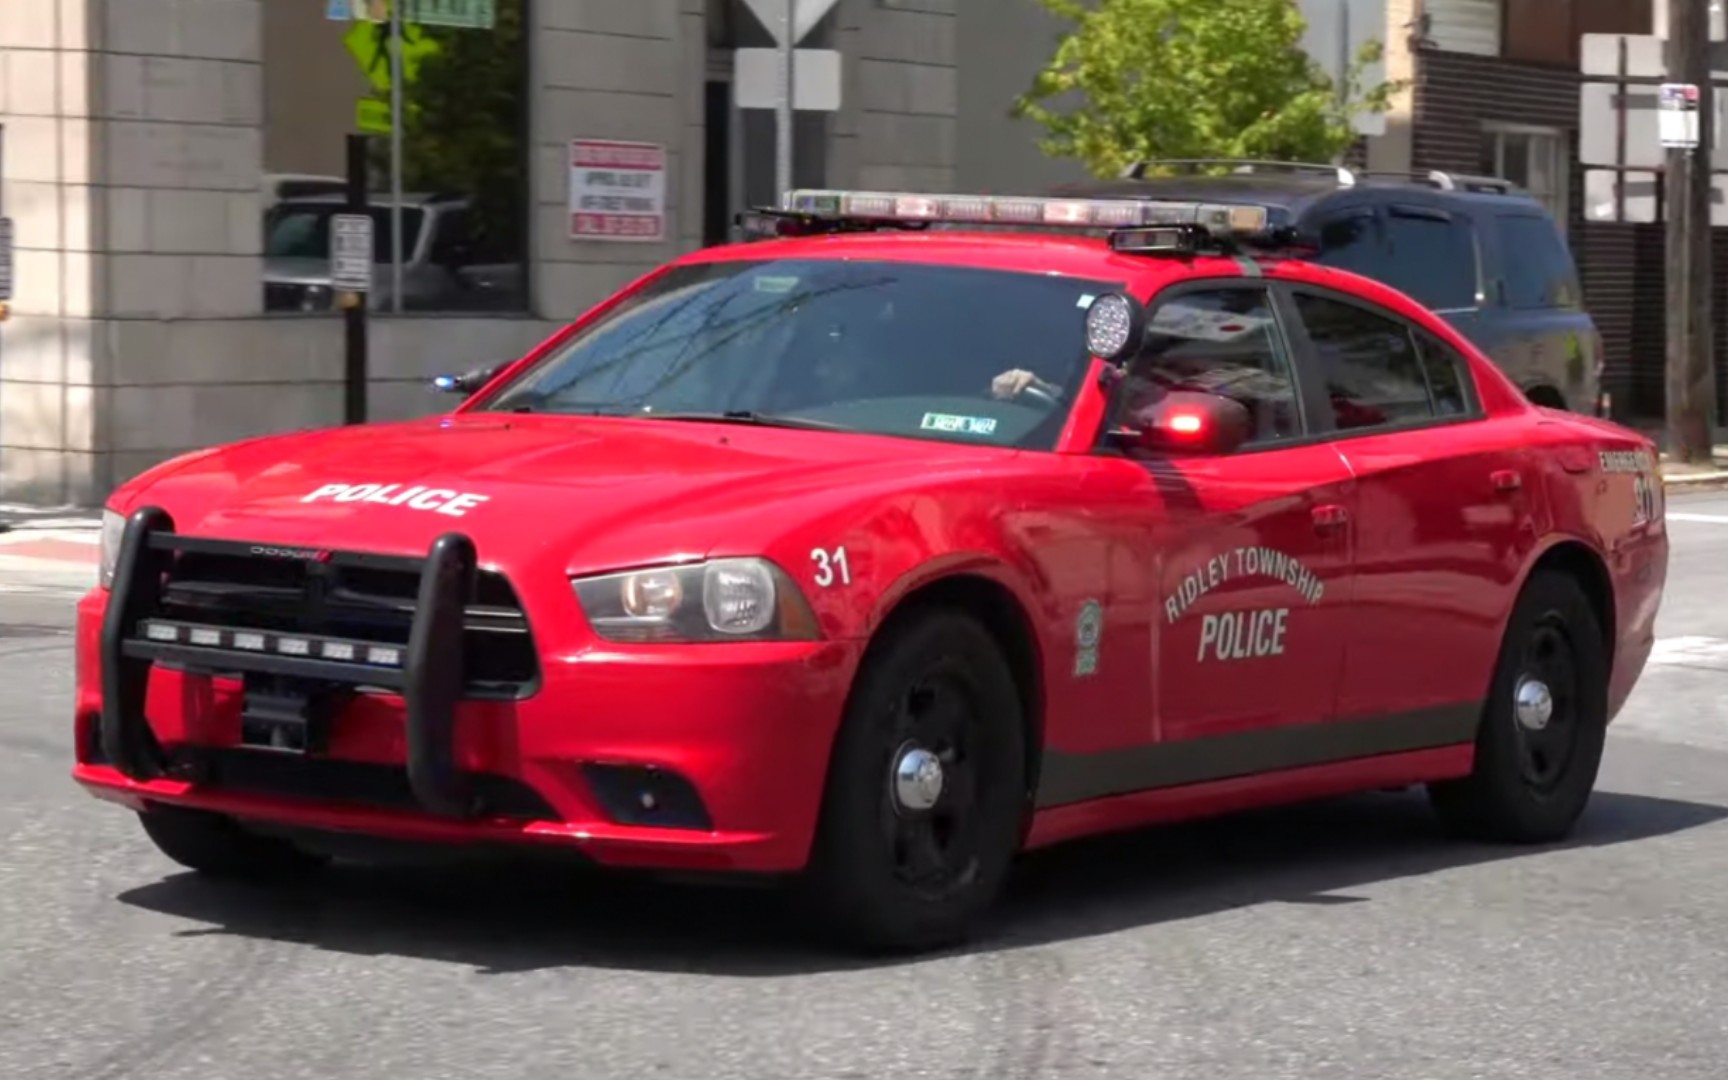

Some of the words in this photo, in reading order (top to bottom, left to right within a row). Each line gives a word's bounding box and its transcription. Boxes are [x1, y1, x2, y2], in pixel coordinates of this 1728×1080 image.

[301, 484, 488, 515] POLICE
[811, 546, 849, 586] 31
[1165, 553, 1228, 624] RIDLEY
[1236, 547, 1324, 605] TOWNSHIP
[1198, 608, 1288, 662] POLICE
